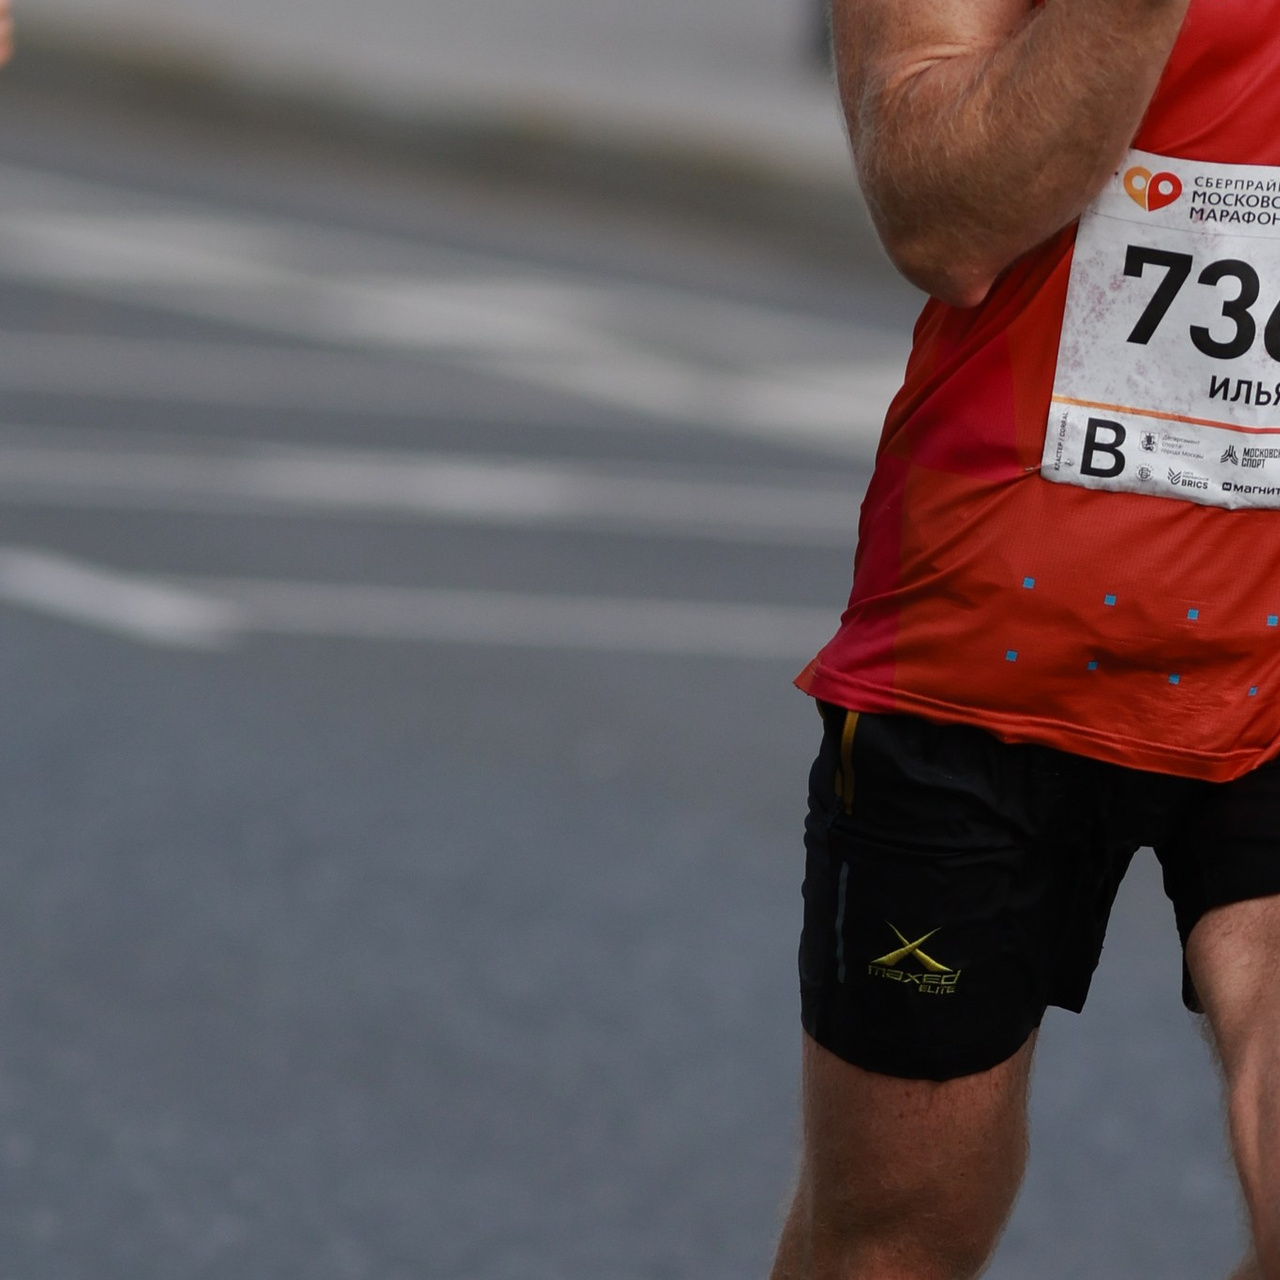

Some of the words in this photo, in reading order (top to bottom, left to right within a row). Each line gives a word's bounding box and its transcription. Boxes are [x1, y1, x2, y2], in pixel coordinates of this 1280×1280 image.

[1241, 457, 1266, 469] СПОРТ
[1181, 478, 1209, 490] BRICS
[918, 984, 956, 995] ELITE
